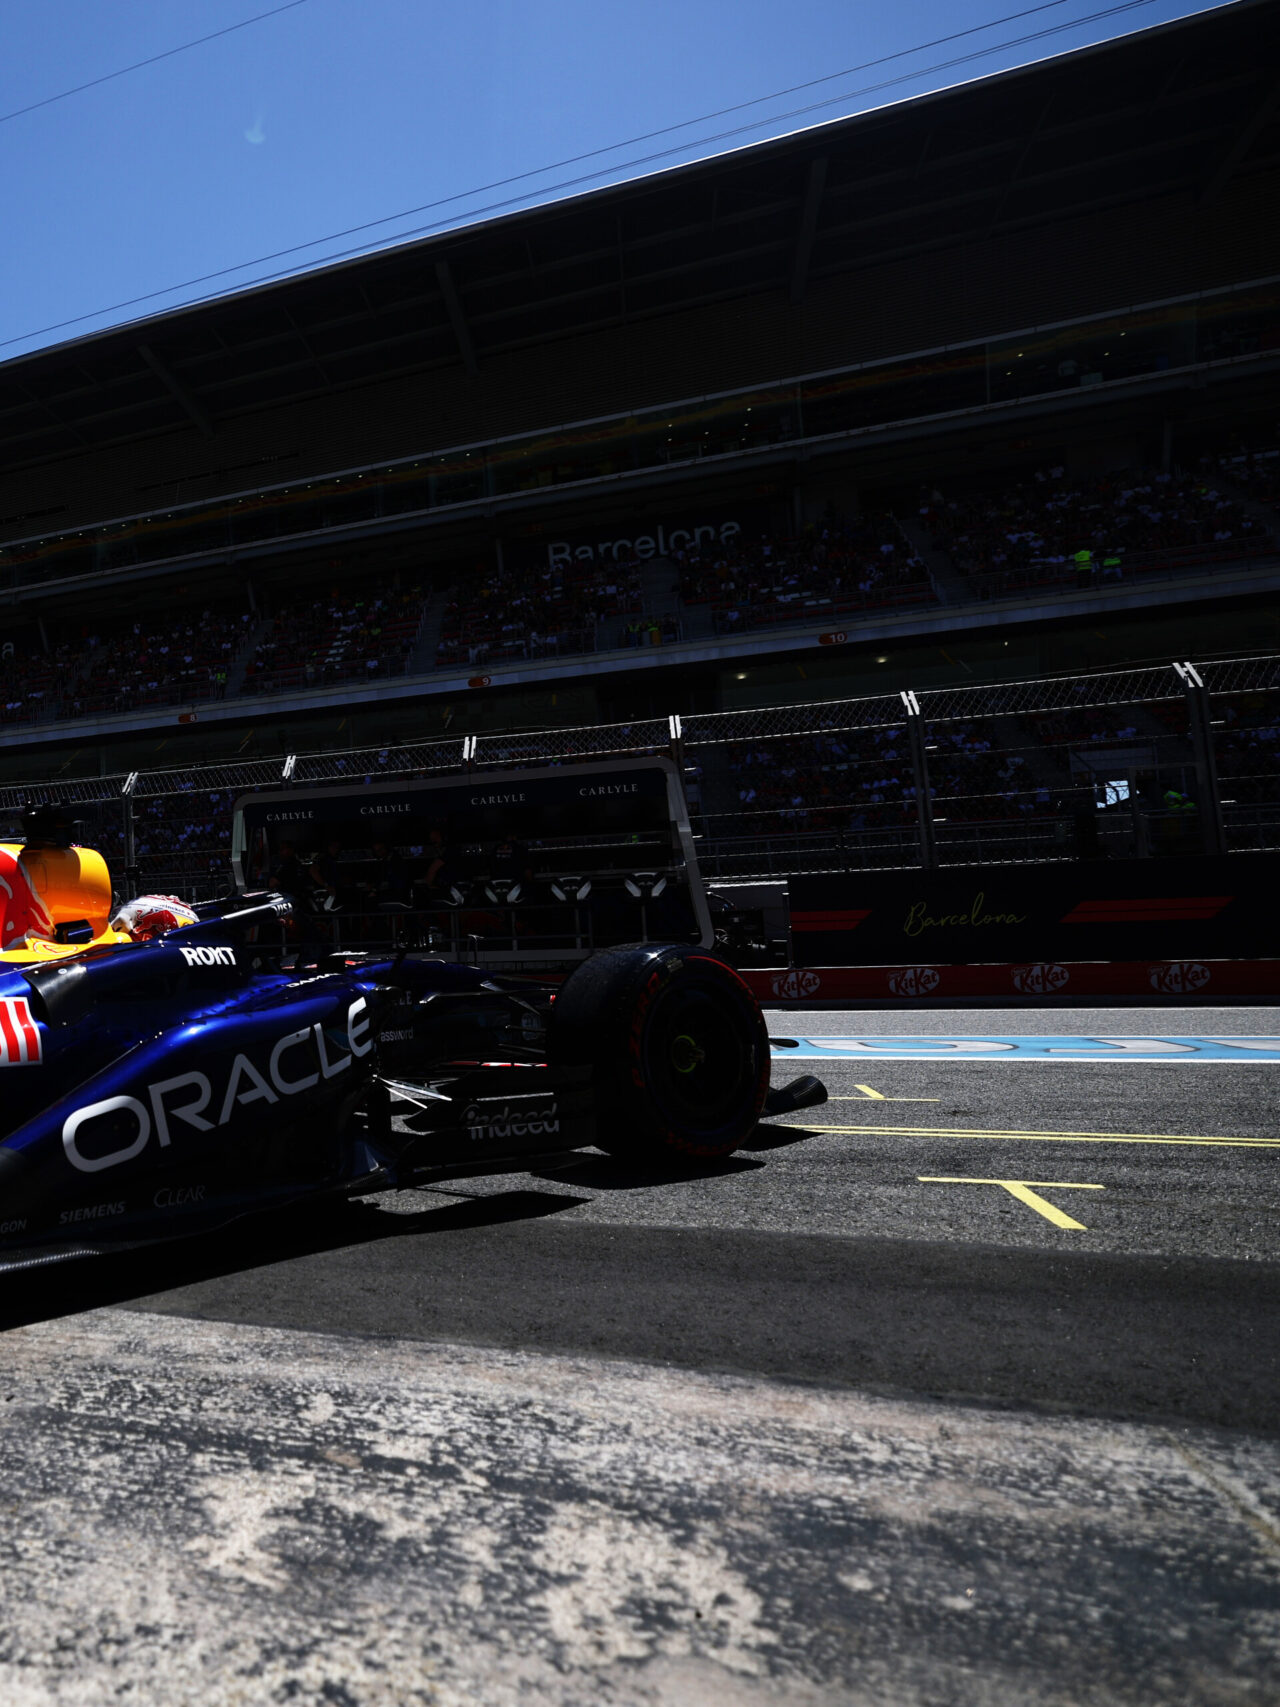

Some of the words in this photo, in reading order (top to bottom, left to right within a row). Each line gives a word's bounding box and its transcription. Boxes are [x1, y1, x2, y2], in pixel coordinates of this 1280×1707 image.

[548, 521, 741, 568] Barcelona
[471, 793, 526, 805] CARLYLE
[579, 783, 639, 797] CARLYLE
[266, 810, 315, 822] CARLYLE
[360, 803, 412, 816] CARLYLE
[904, 891, 1027, 936] Barcelona
[179, 947, 237, 966] ROKT
[776, 972, 820, 997] KitKat
[894, 969, 938, 995] KitKat
[1021, 966, 1068, 992] KitKat
[1157, 964, 1208, 992] KitKat
[380, 1025, 414, 1042] assword
[62, 997, 375, 1173] ORACLE
[462, 1102, 560, 1140] indeed
[153, 1185, 206, 1208] CLEAR
[59, 1201, 127, 1225] SIEMENS
